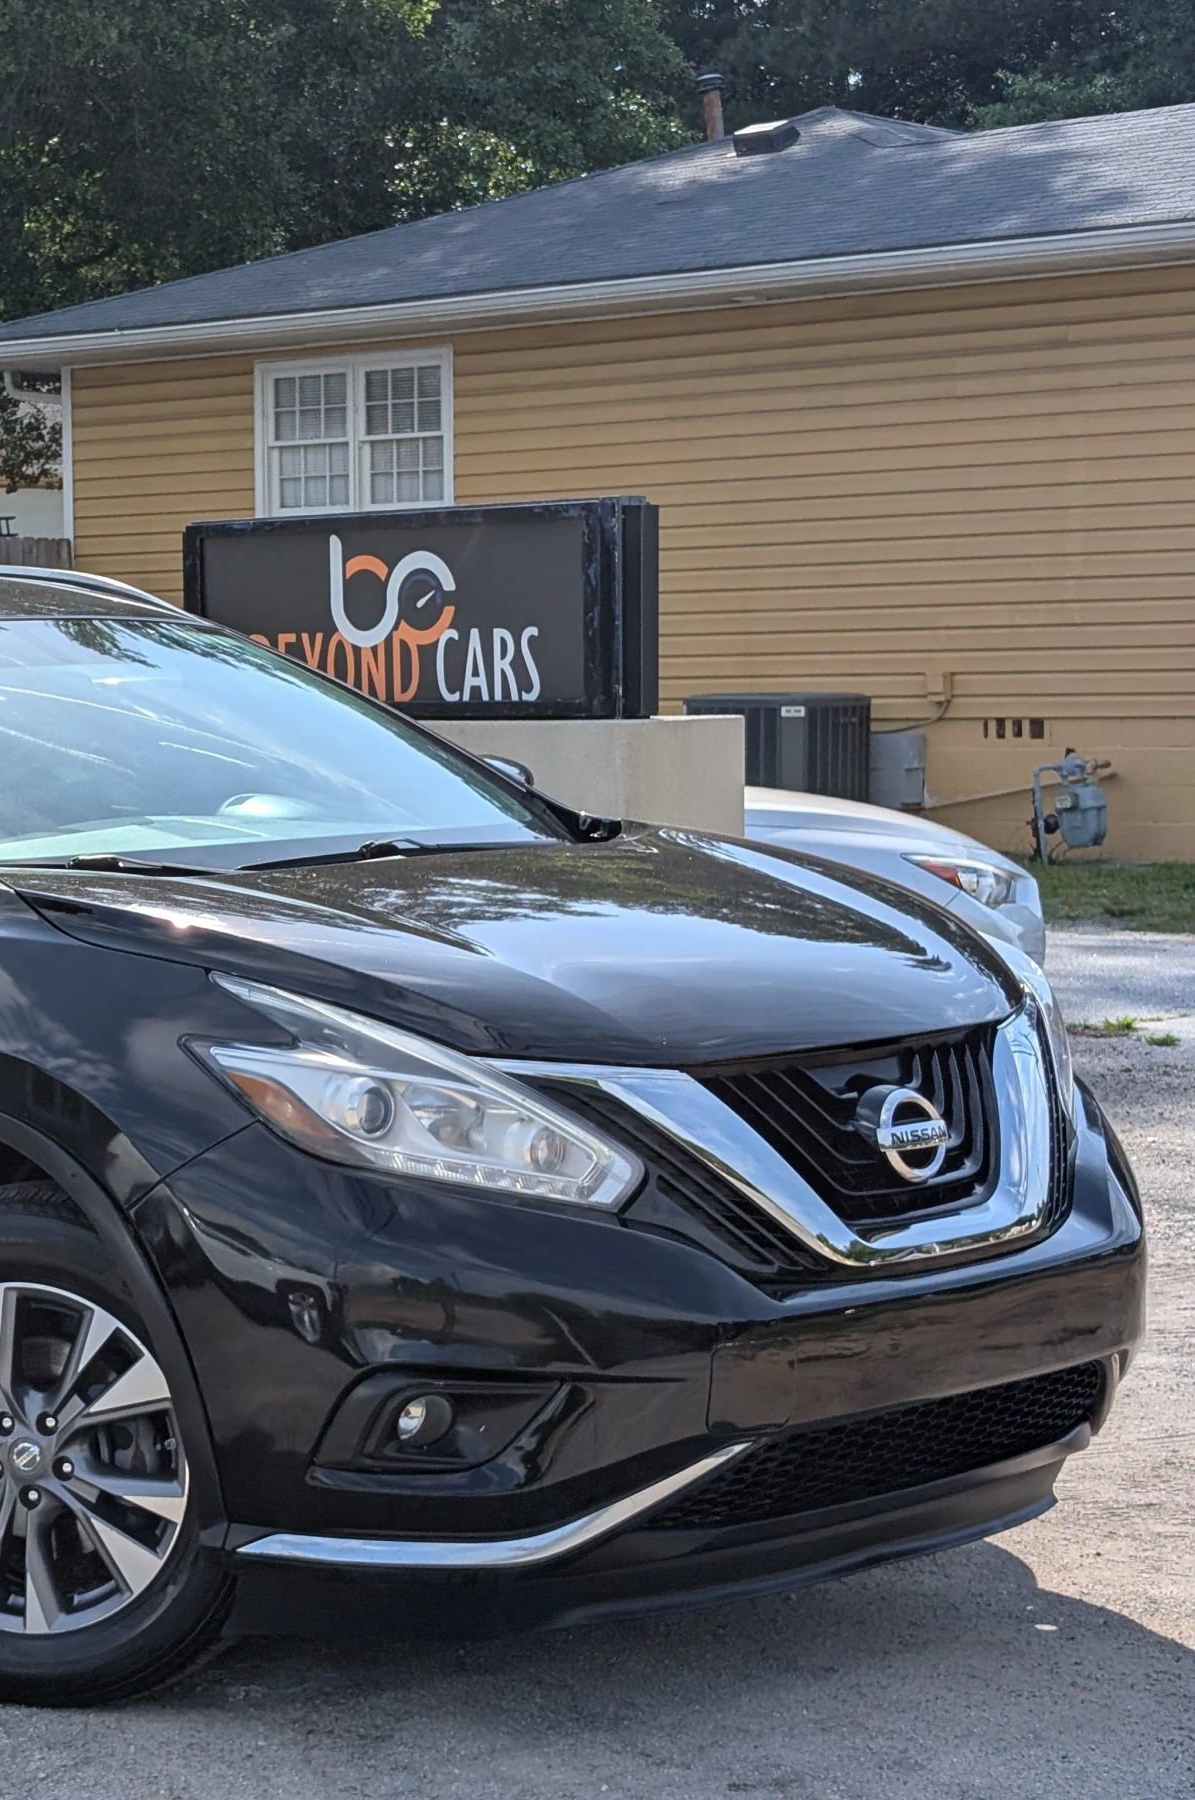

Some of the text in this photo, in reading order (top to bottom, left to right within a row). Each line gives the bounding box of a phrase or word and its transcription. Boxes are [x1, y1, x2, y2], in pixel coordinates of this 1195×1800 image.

[249, 626, 540, 702] YOND CARS
[891, 1126, 948, 1146] NISSAN
